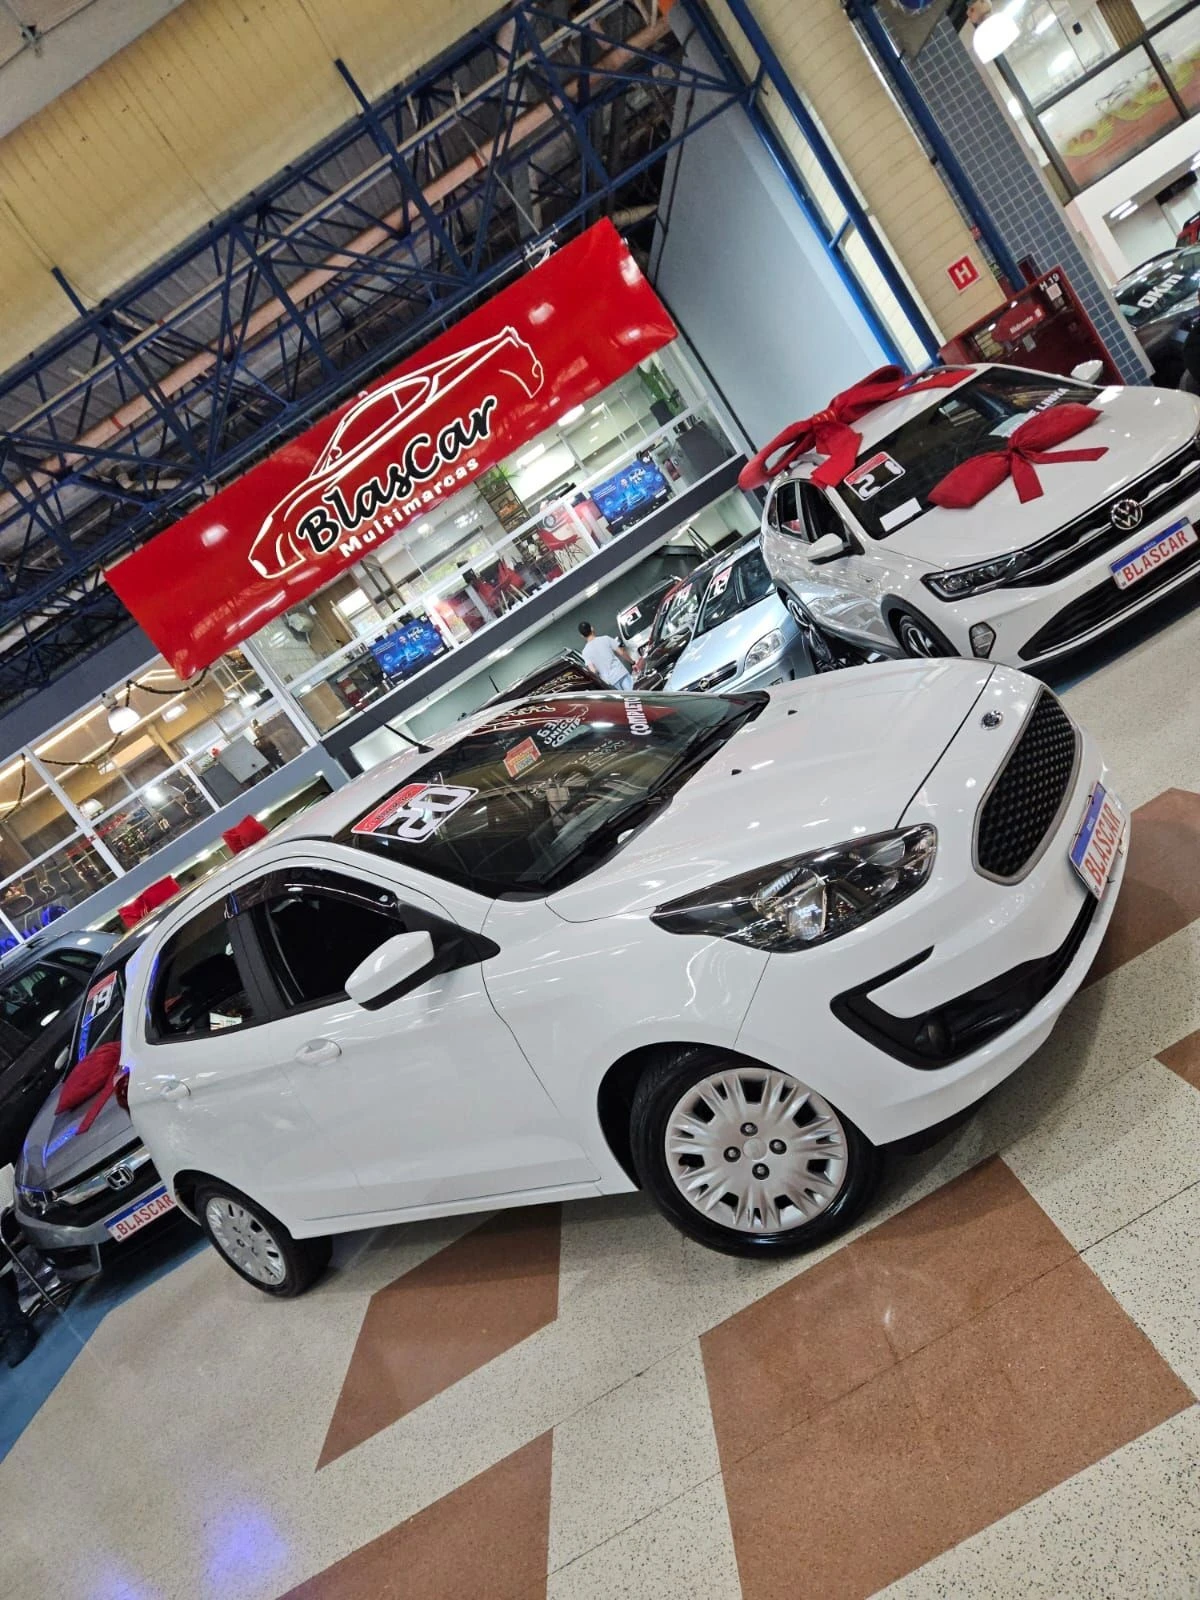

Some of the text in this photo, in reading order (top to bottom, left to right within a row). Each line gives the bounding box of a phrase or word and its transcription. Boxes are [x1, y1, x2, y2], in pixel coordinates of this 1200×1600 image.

[954, 264, 972, 284] H
[1039, 272, 1060, 291] H 19
[1035, 387, 1070, 411] LINHA
[297, 396, 497, 555] BlasCar
[853, 460, 902, 498] 21
[338, 457, 479, 558] Multimarcas
[1122, 530, 1188, 582] BLASCAR
[624, 697, 652, 735] COMPLETO
[378, 787, 472, 838] 20
[1085, 802, 1121, 886] BLASCAR
[91, 985, 113, 1016] 19
[116, 1194, 174, 1236] BLASCAR
